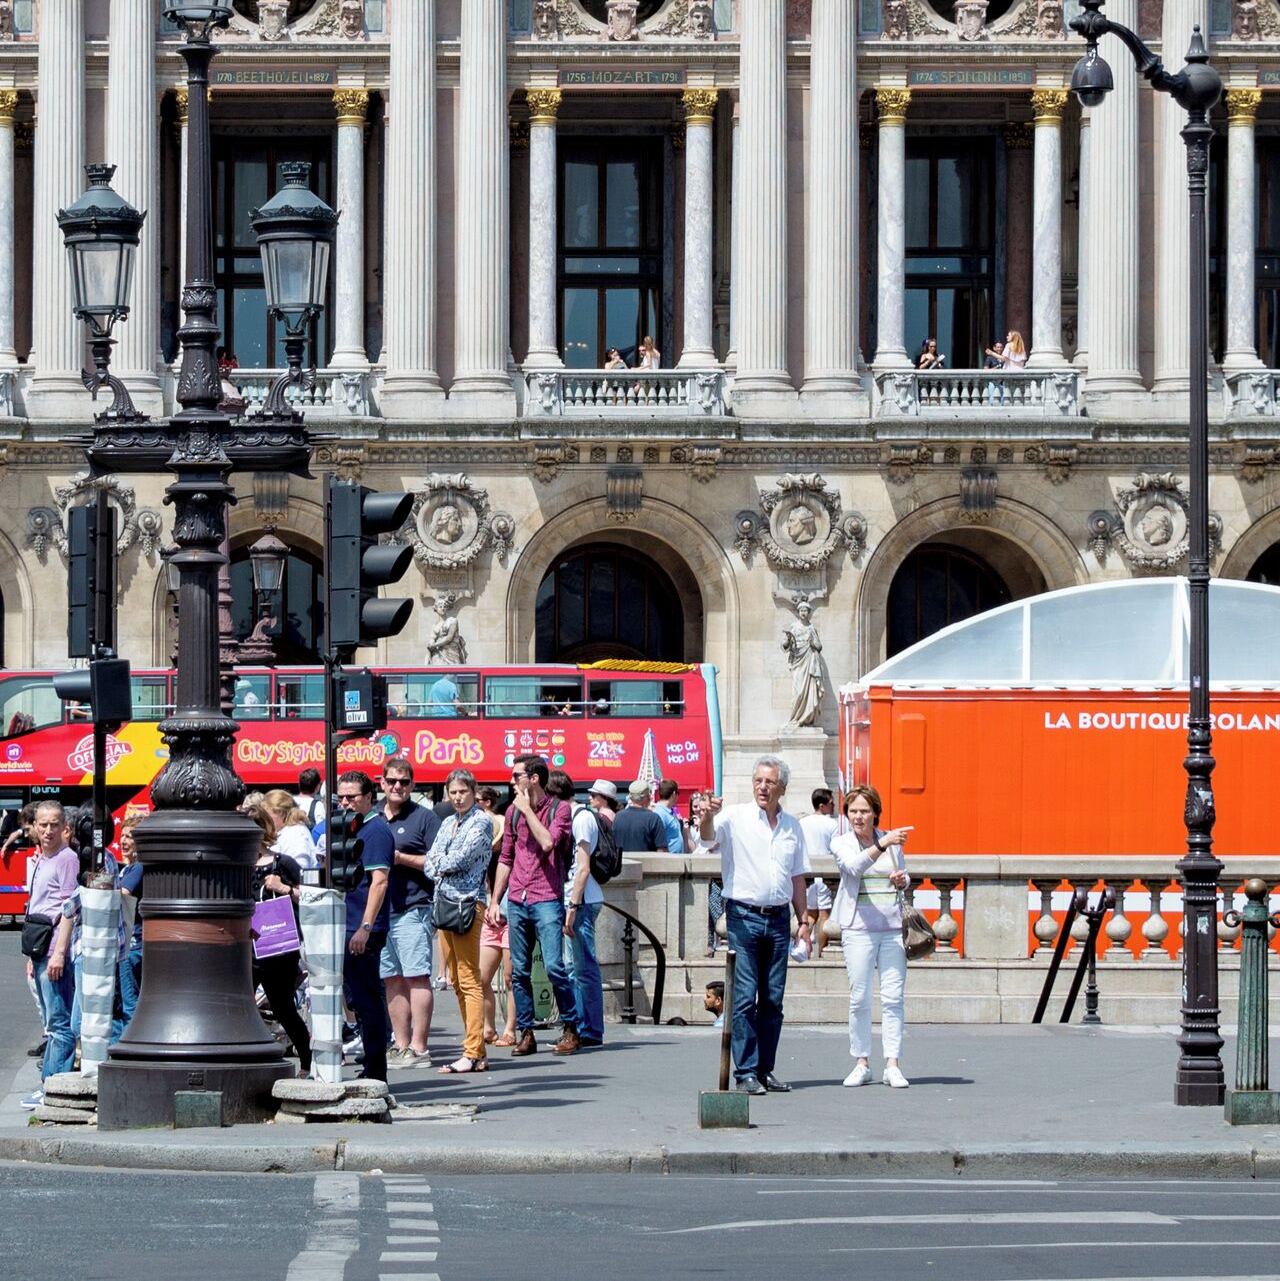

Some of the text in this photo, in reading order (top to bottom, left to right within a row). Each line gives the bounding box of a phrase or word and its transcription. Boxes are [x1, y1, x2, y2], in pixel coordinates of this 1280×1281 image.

[235, 71, 309, 83] BEETHOVEN
[566, 71, 678, 83] 1756 MOZART 1791
[1008, 73, 1026, 82] 1851
[1044, 712, 1072, 729] LA
[238, 730, 484, 765] City Sighteeing Paris
[589, 740, 609, 759] 24
[666, 741, 697, 752] Hop On
[667, 751, 699, 764] Hop Off
